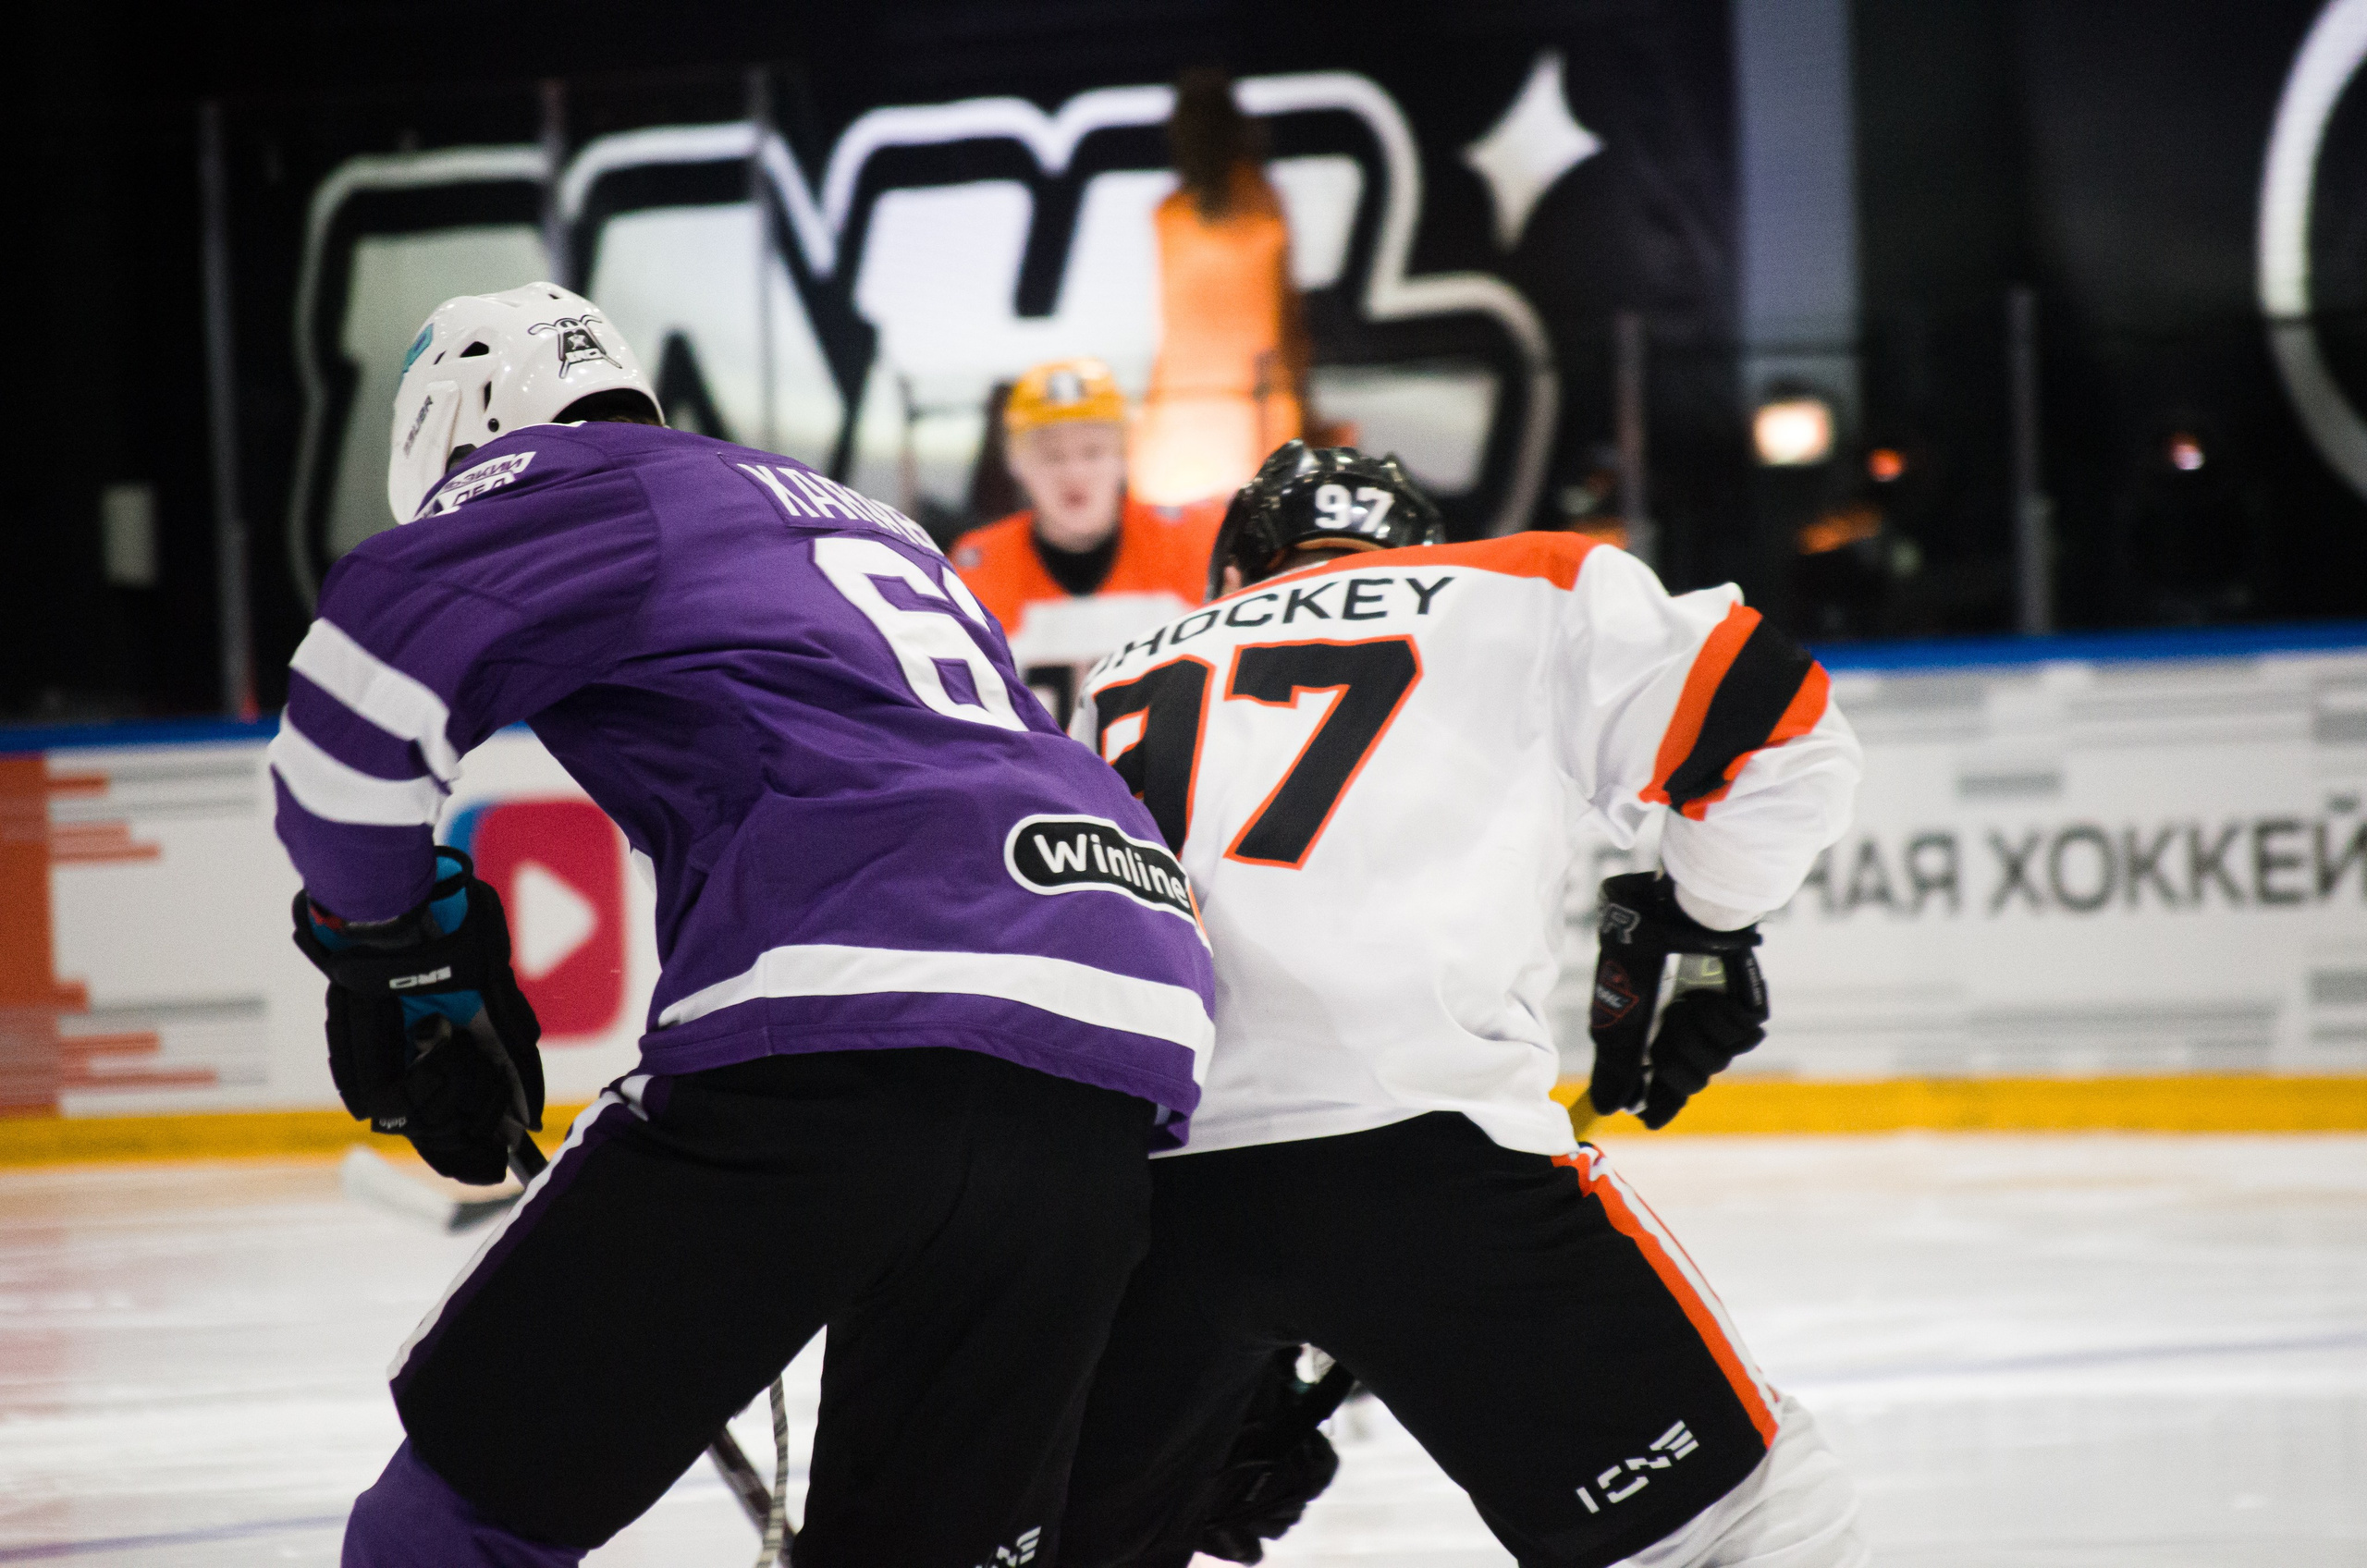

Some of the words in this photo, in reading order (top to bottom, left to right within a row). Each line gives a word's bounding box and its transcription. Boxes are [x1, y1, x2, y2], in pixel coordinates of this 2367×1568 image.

[1315, 483, 1393, 533] 97
[814, 536, 1030, 731] 6
[1095, 576, 1456, 677] HOCKEY
[1033, 833, 1191, 910] Winline
